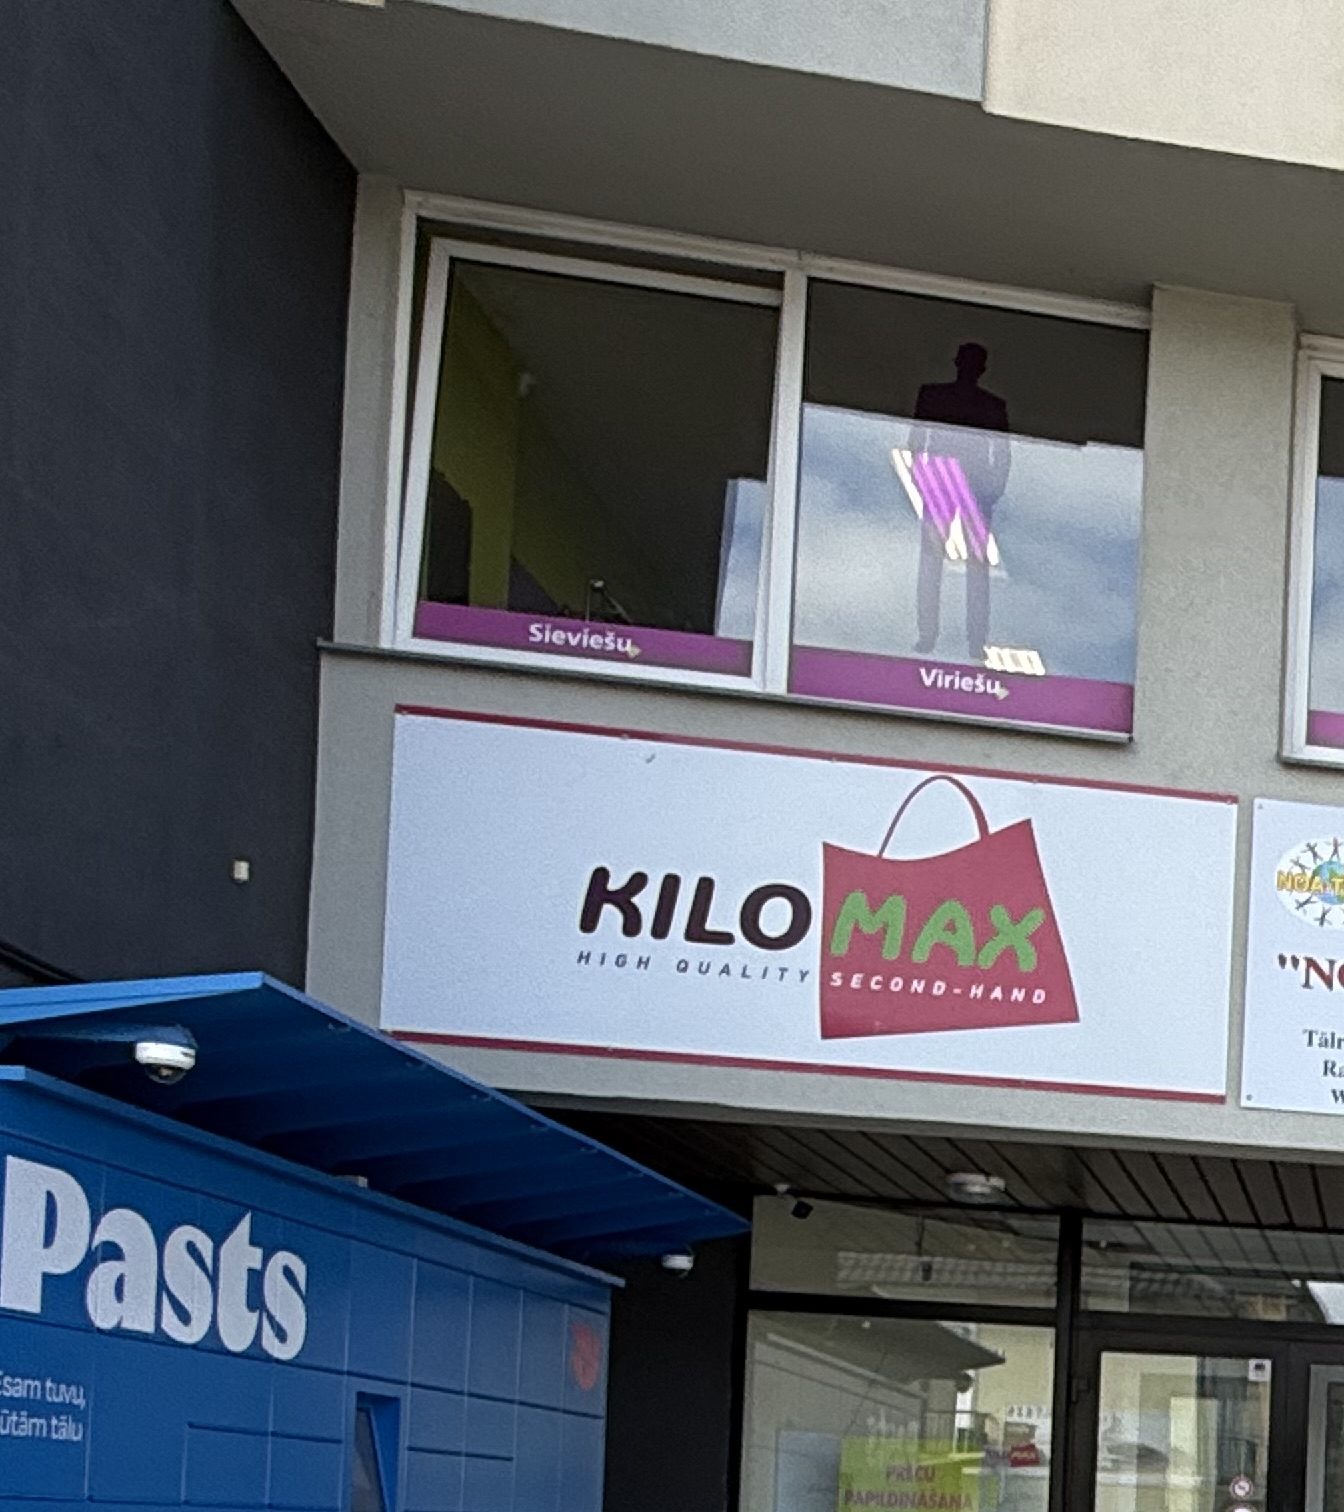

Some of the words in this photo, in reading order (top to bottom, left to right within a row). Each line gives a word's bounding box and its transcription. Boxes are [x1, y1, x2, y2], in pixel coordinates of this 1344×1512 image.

[528, 622, 633, 653] Sieviešu
[579, 866, 813, 951] KILO
[830, 889, 1045, 972] MAX
[577, 950, 651, 971] HIGH
[676, 958, 810, 983] QUALITY
[830, 971, 1047, 1004] SECOND-HAND
[0, 1154, 308, 1361] Pasts
[0, 1409, 48, 1438] ūtām
[51, 1414, 83, 1442] tālu
